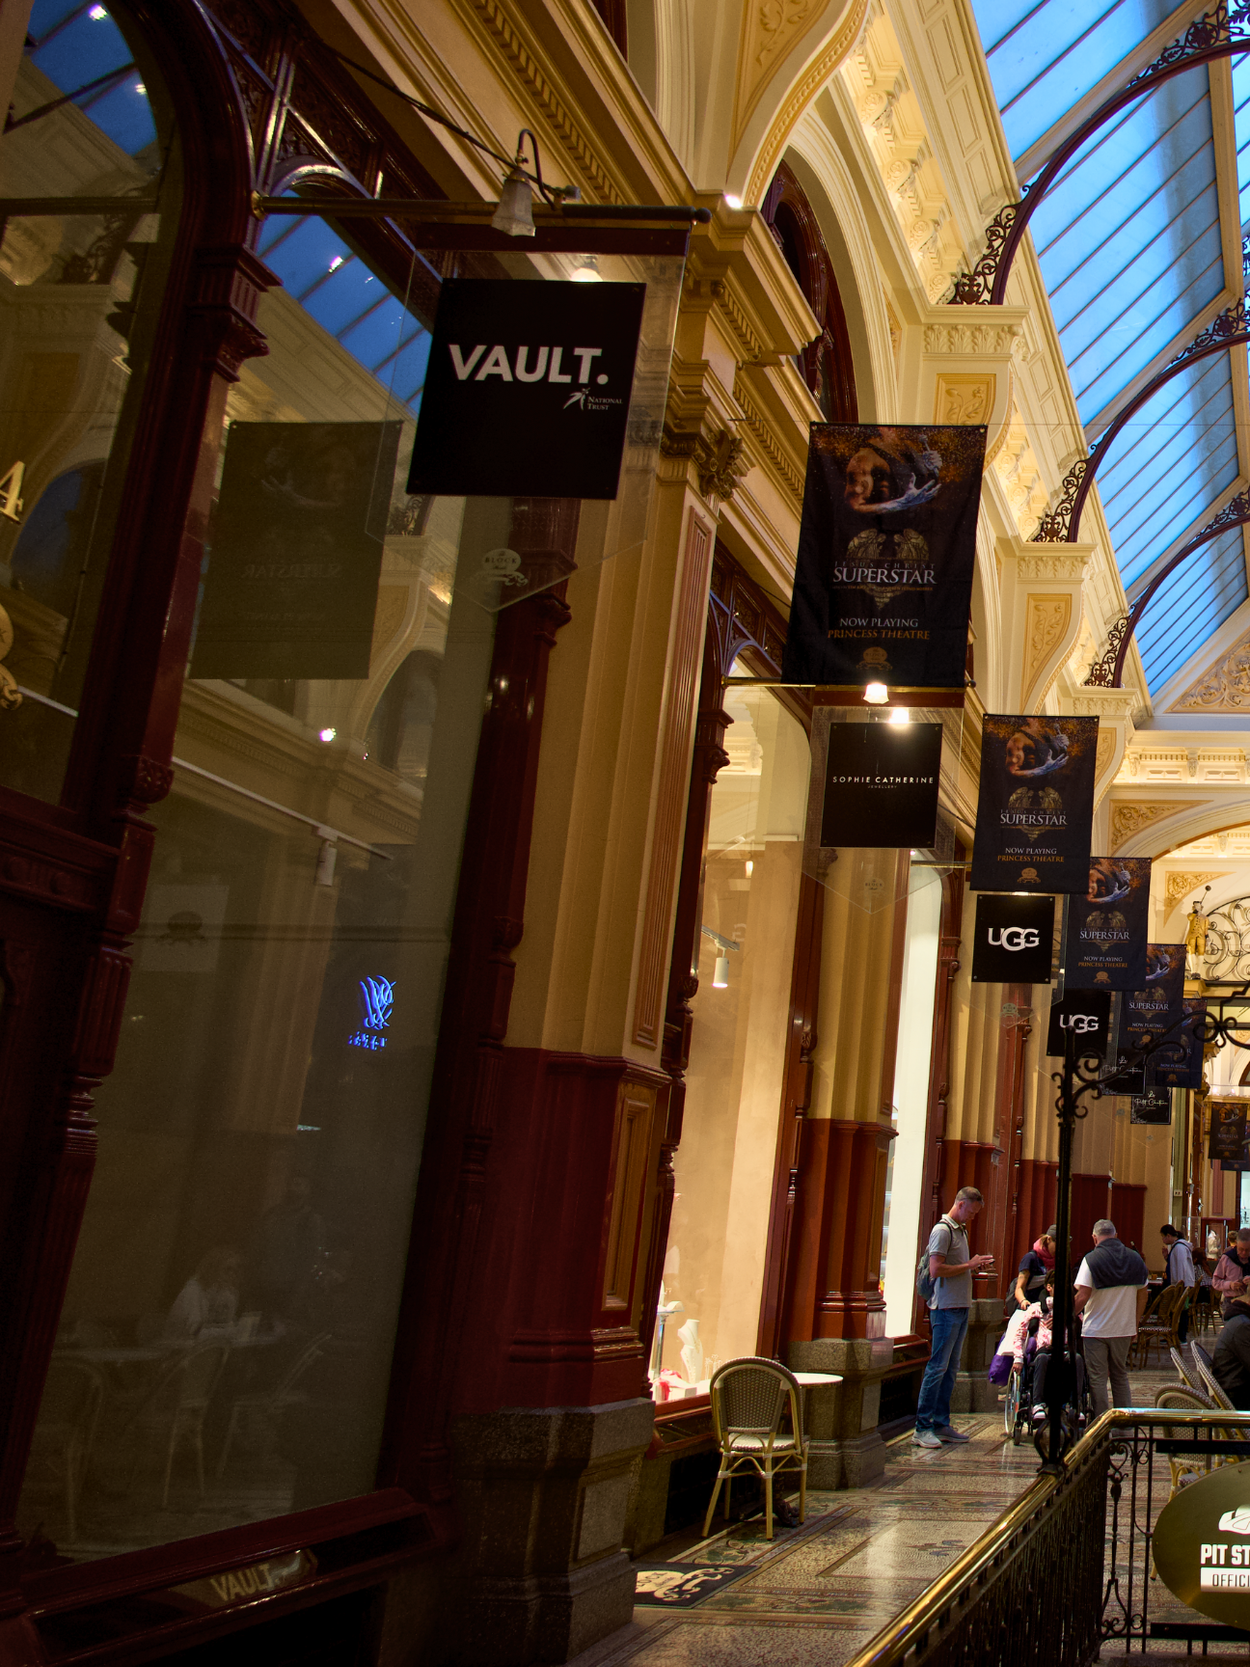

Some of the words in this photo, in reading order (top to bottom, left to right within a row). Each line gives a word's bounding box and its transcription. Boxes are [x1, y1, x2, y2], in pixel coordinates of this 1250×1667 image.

[448, 343, 609, 385] VAULT.
[587, 396, 623, 405] NATIONAL
[587, 402, 610, 411] TRUST
[885, 561, 936, 569] CHRIST
[833, 567, 938, 585] SUPERSTAR
[839, 618, 869, 627] NOW
[871, 618, 919, 628] PLAYING
[827, 629, 878, 639] PRINCESS
[880, 630, 930, 640] THEATRE
[832, 775, 871, 784] SOPHIE
[875, 776, 934, 785] CATHERINE
[1000, 813, 1069, 826] SUPERSTAR
[987, 926, 1041, 952] UGG
[1079, 931, 1131, 940] SUPERSTAR
[1128, 1002, 1170, 1011] SUPERSTAR
[1059, 1014, 1100, 1034] UGG
[1200, 1543, 1228, 1565] PIT
[210, 1563, 275, 1602] VAULT
